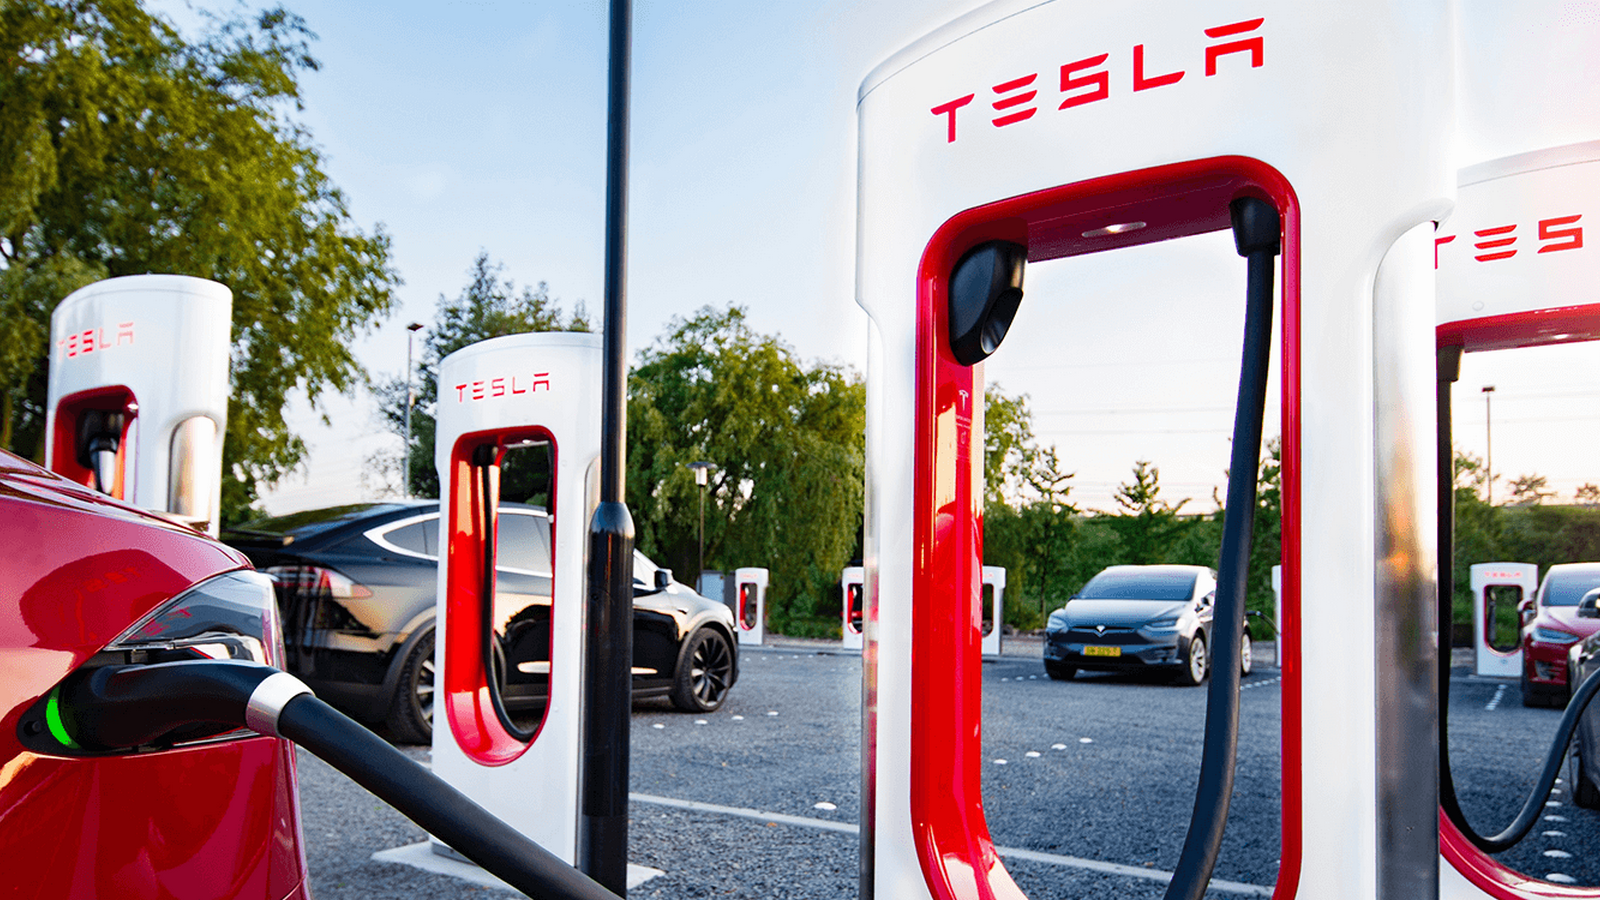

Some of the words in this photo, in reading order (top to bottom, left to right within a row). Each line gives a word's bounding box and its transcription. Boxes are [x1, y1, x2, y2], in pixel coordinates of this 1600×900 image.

[930, 17, 1265, 144] TESLA
[56, 321, 134, 361] TESLA
[455, 372, 550, 403] TESLA
